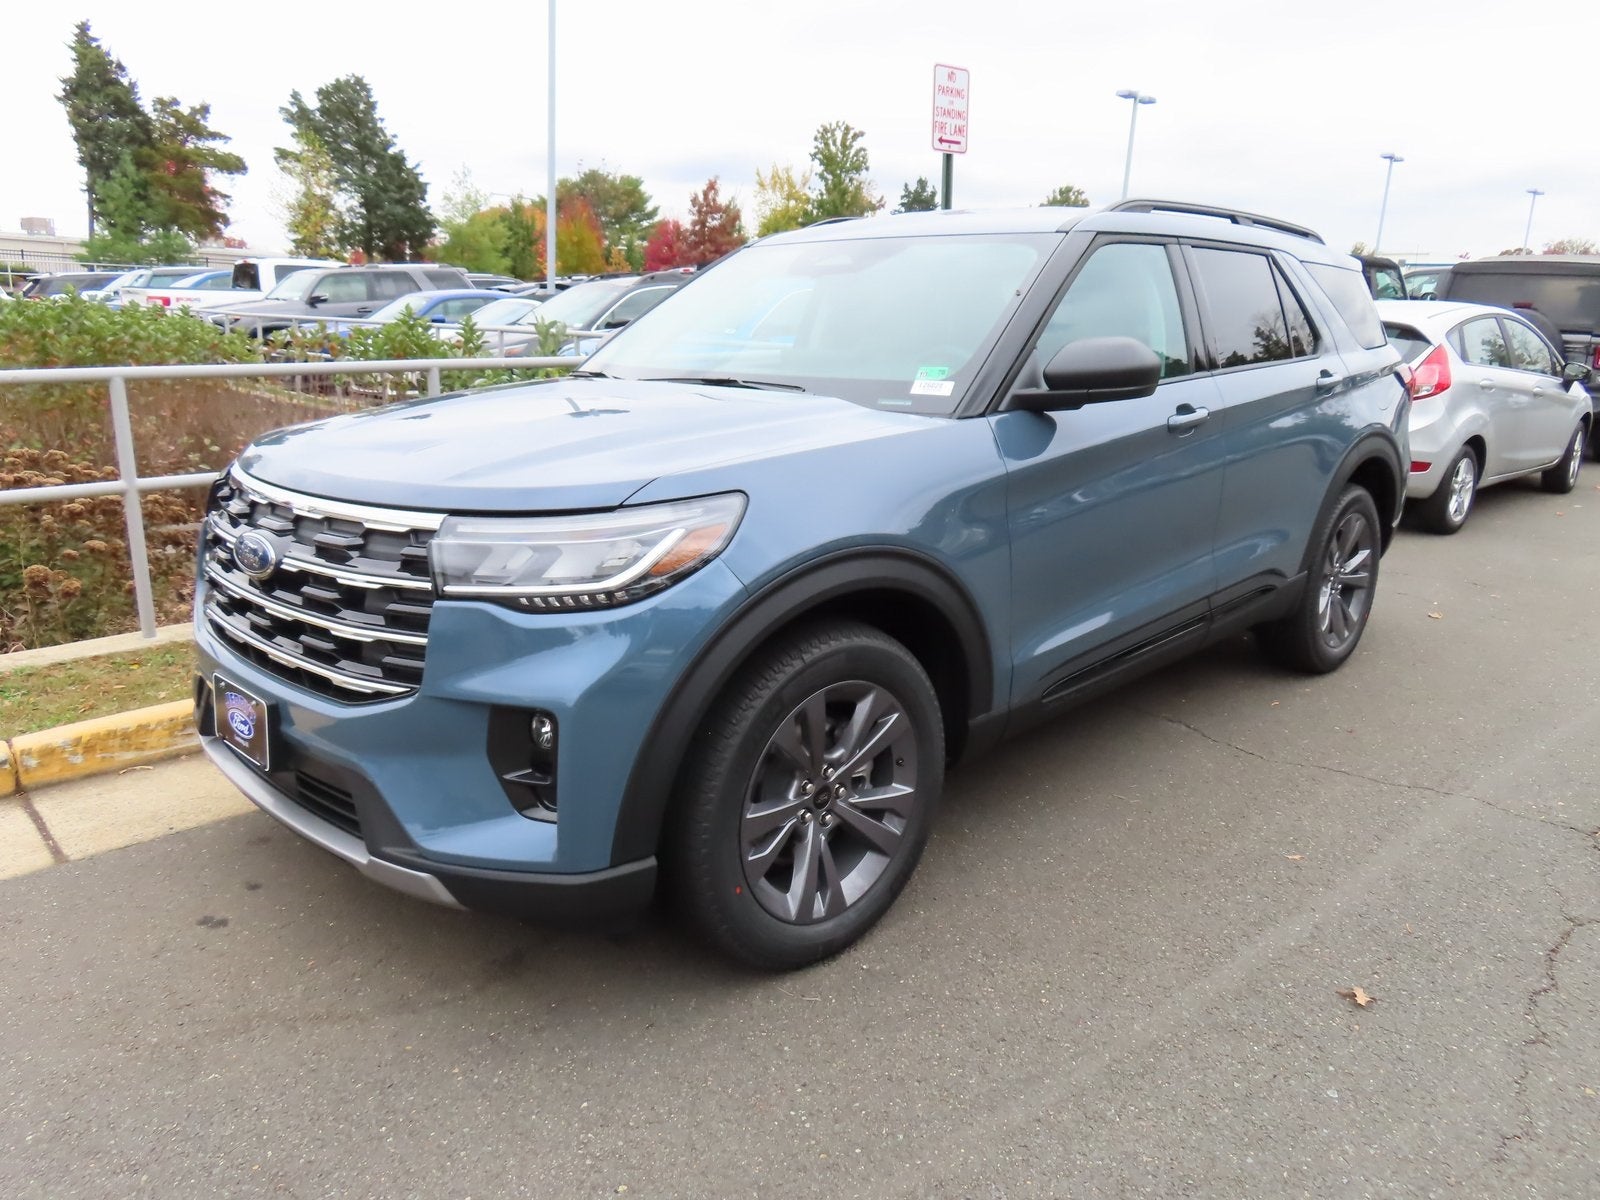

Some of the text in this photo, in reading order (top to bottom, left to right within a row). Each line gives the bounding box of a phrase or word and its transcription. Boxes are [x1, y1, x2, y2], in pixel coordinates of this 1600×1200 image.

[947, 71, 956, 83] NO
[937, 84, 965, 99] PARKING
[936, 106, 966, 121] STANDING
[934, 120, 966, 137] FIRE LANE
[232, 712, 250, 735] Ford
